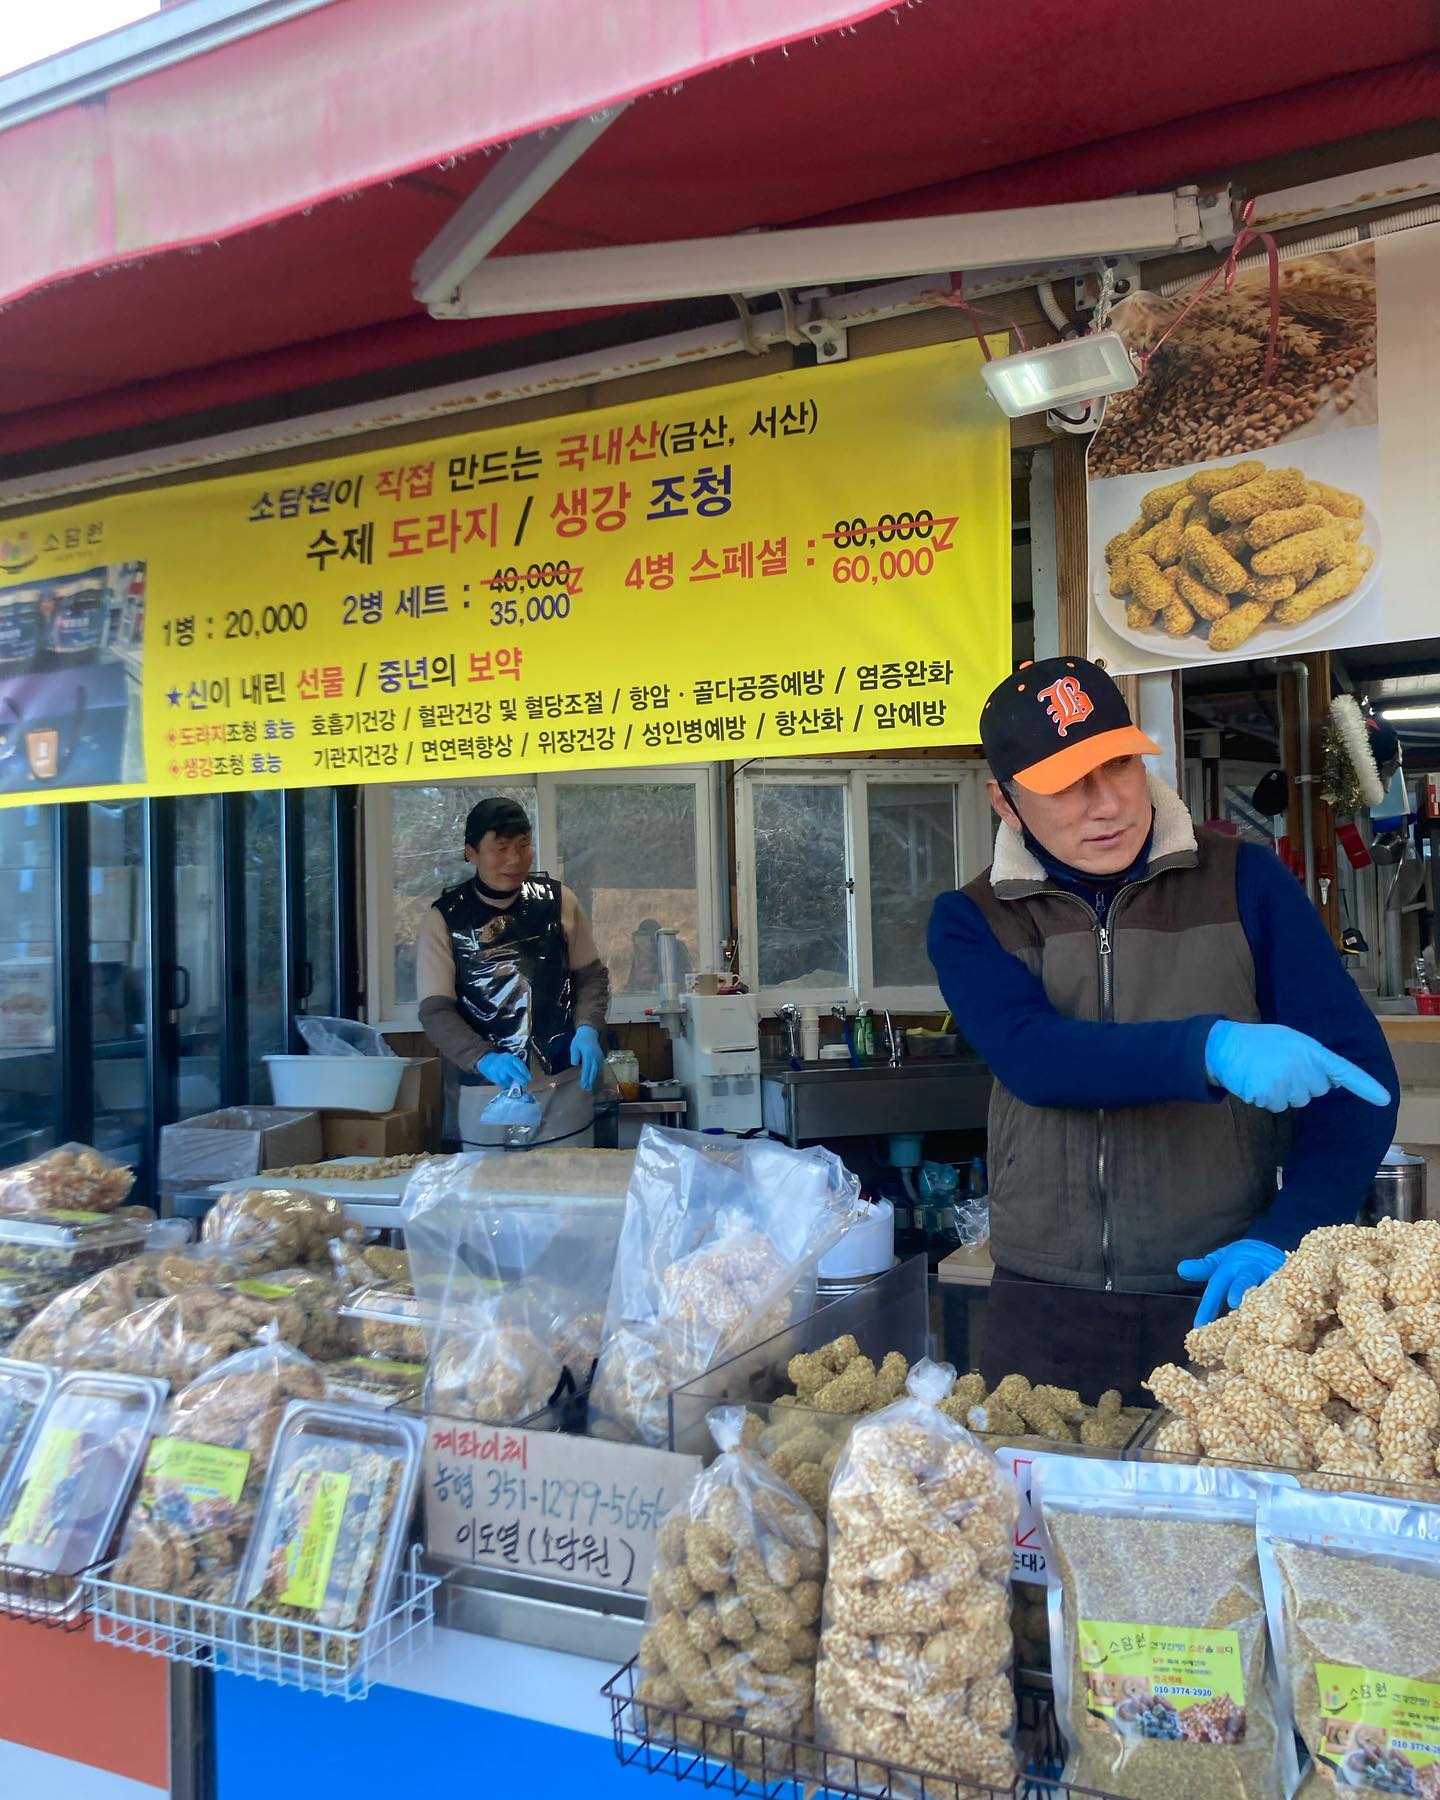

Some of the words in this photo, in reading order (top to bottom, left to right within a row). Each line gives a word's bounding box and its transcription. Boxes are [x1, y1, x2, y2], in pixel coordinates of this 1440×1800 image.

[248, 475, 364, 522] 소담원이
[376, 461, 435, 501] 직접
[448, 446, 543, 492] 만드는
[556, 414, 735, 471] 국내산(금산,
[748, 399, 819, 439] 서산)
[306, 522, 375, 571] 수제
[388, 502, 498, 558] 도라지
[513, 495, 534, 546] /
[549, 481, 632, 538] 생강
[646, 464, 733, 521] 조청
[832, 509, 934, 550] 80,000
[489, 559, 571, 596] 40,000
[625, 552, 675, 590] 4병
[688, 536, 788, 582] 스페셜
[831, 546, 934, 585] 60,000
[163, 614, 196, 647] 1병
[225, 602, 308, 641] 20,000
[343, 590, 383, 625] 2병
[395, 584, 448, 619] 세트
[489, 593, 571, 627] 35,000
[179, 720, 258, 746] 도라지조청
[264, 717, 295, 741] 효능
[312, 708, 396, 737] 호흡기건강
[419, 700, 492, 729] 혈관건강
[499, 697, 518, 722] 및
[525, 690, 603, 719] 혈당조절
[612, 688, 621, 714] /
[630, 683, 670, 711] 항암
[693, 668, 825, 705] 골다공증예방
[834, 666, 847, 694] /
[856, 659, 954, 691] 염증완화
[187, 677, 231, 711] 신이
[242, 671, 286, 705] 내린
[296, 665, 345, 701] 선물
[355, 662, 368, 698] /
[378, 653, 456, 693] 중년의
[467, 646, 522, 683] 보약
[1037, 676, 1095, 737] B
[184, 754, 245, 779] 생강조청
[251, 752, 283, 774] 효능
[313, 743, 398, 770] 기관지건강
[422, 734, 513, 763] 면연력향상
[538, 726, 616, 754] 위장건강
[624, 724, 633, 750] /
[642, 714, 747, 747] 성인병예방
[755, 712, 766, 739] /
[775, 707, 844, 737] 항산화
[853, 705, 864, 732] /
[873, 700, 947, 730] 암예방
[432, 1426, 528, 1470] 계좌이체
